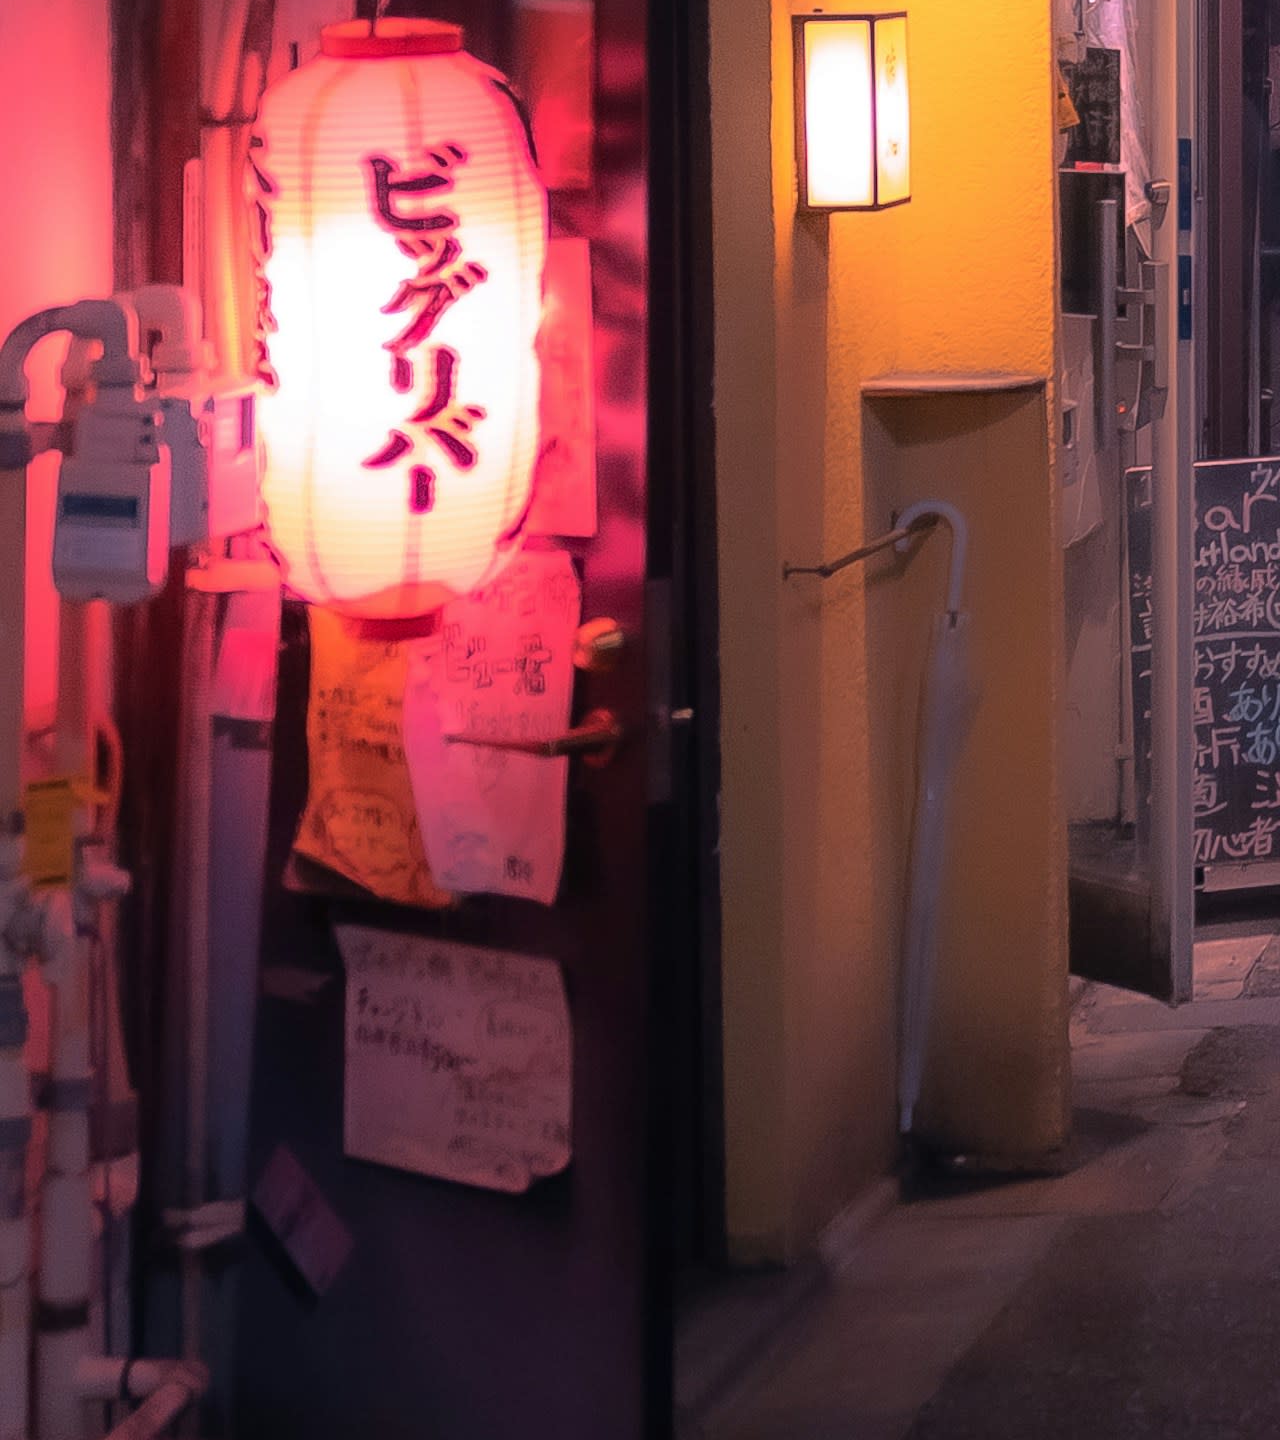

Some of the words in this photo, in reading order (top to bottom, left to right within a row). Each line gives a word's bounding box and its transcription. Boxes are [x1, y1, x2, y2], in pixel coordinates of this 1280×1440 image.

[362, 145, 489, 514] ビッグリバー
[1193, 491, 1278, 534] ar
